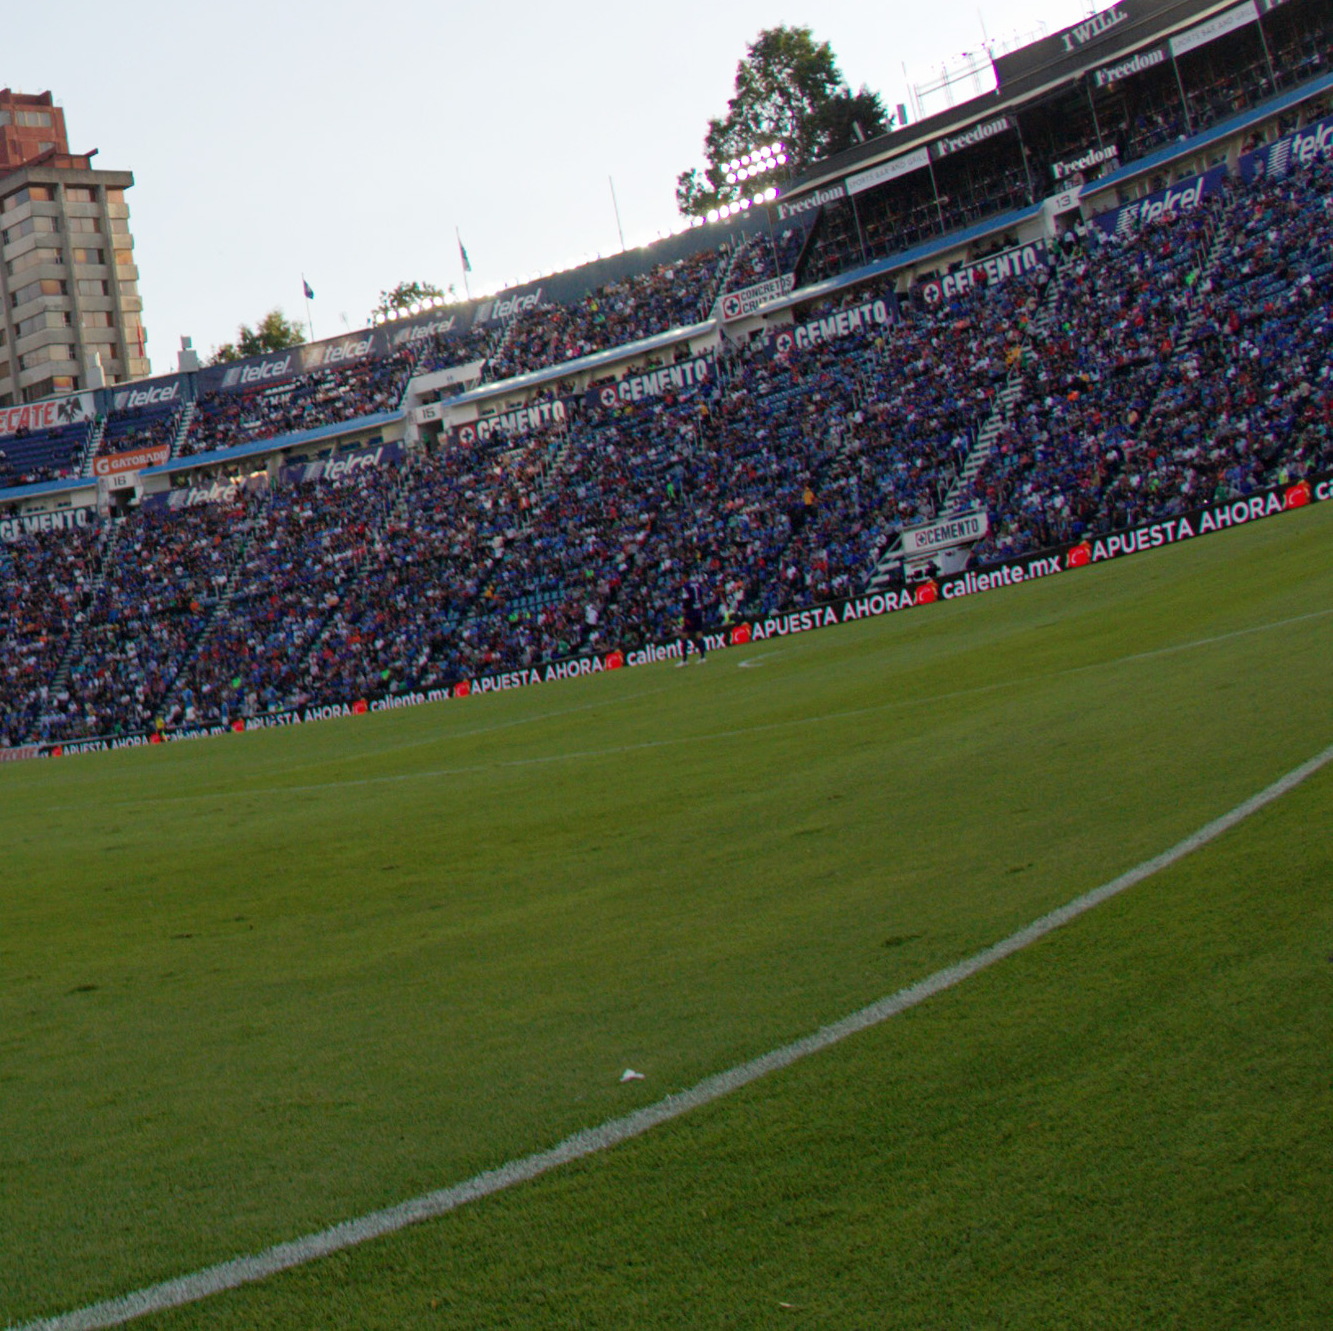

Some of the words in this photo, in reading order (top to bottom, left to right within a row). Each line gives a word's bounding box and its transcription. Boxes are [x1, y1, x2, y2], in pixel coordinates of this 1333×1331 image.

[1060, 30, 1076, 53] I
[1095, 48, 1164, 88] Freedom
[936, 117, 1009, 158] Freedom
[1293, 123, 1333, 170] telc
[1052, 143, 1118, 180] Freedom
[777, 184, 845, 220] Freedom
[1140, 176, 1206, 223] telcel
[491, 287, 543, 320] telcel
[410, 316, 456, 341] telcel
[794, 300, 886, 350] CEMENTO
[323, 334, 375, 365] telcel
[240, 355, 292, 384] telcel
[617, 358, 708, 400] CEMENTO
[128, 381, 180, 408] telcel
[475, 400, 566, 440] CEMENTO
[110, 448, 169, 471] GATORADE
[927, 517, 980, 544] CEMENTO
[751, 605, 838, 642] APUESTA
[842, 588, 915, 622] AHORA
[941, 553, 1063, 600] caliente.mx
[1091, 518, 1196, 562] APUESTA
[1199, 491, 1283, 534] AHORA
[303, 702, 352, 723] AHORA
[370, 686, 451, 713] caliente.mx
[470, 670, 541, 696] APUESTA
[545, 655, 604, 682] AHORA
